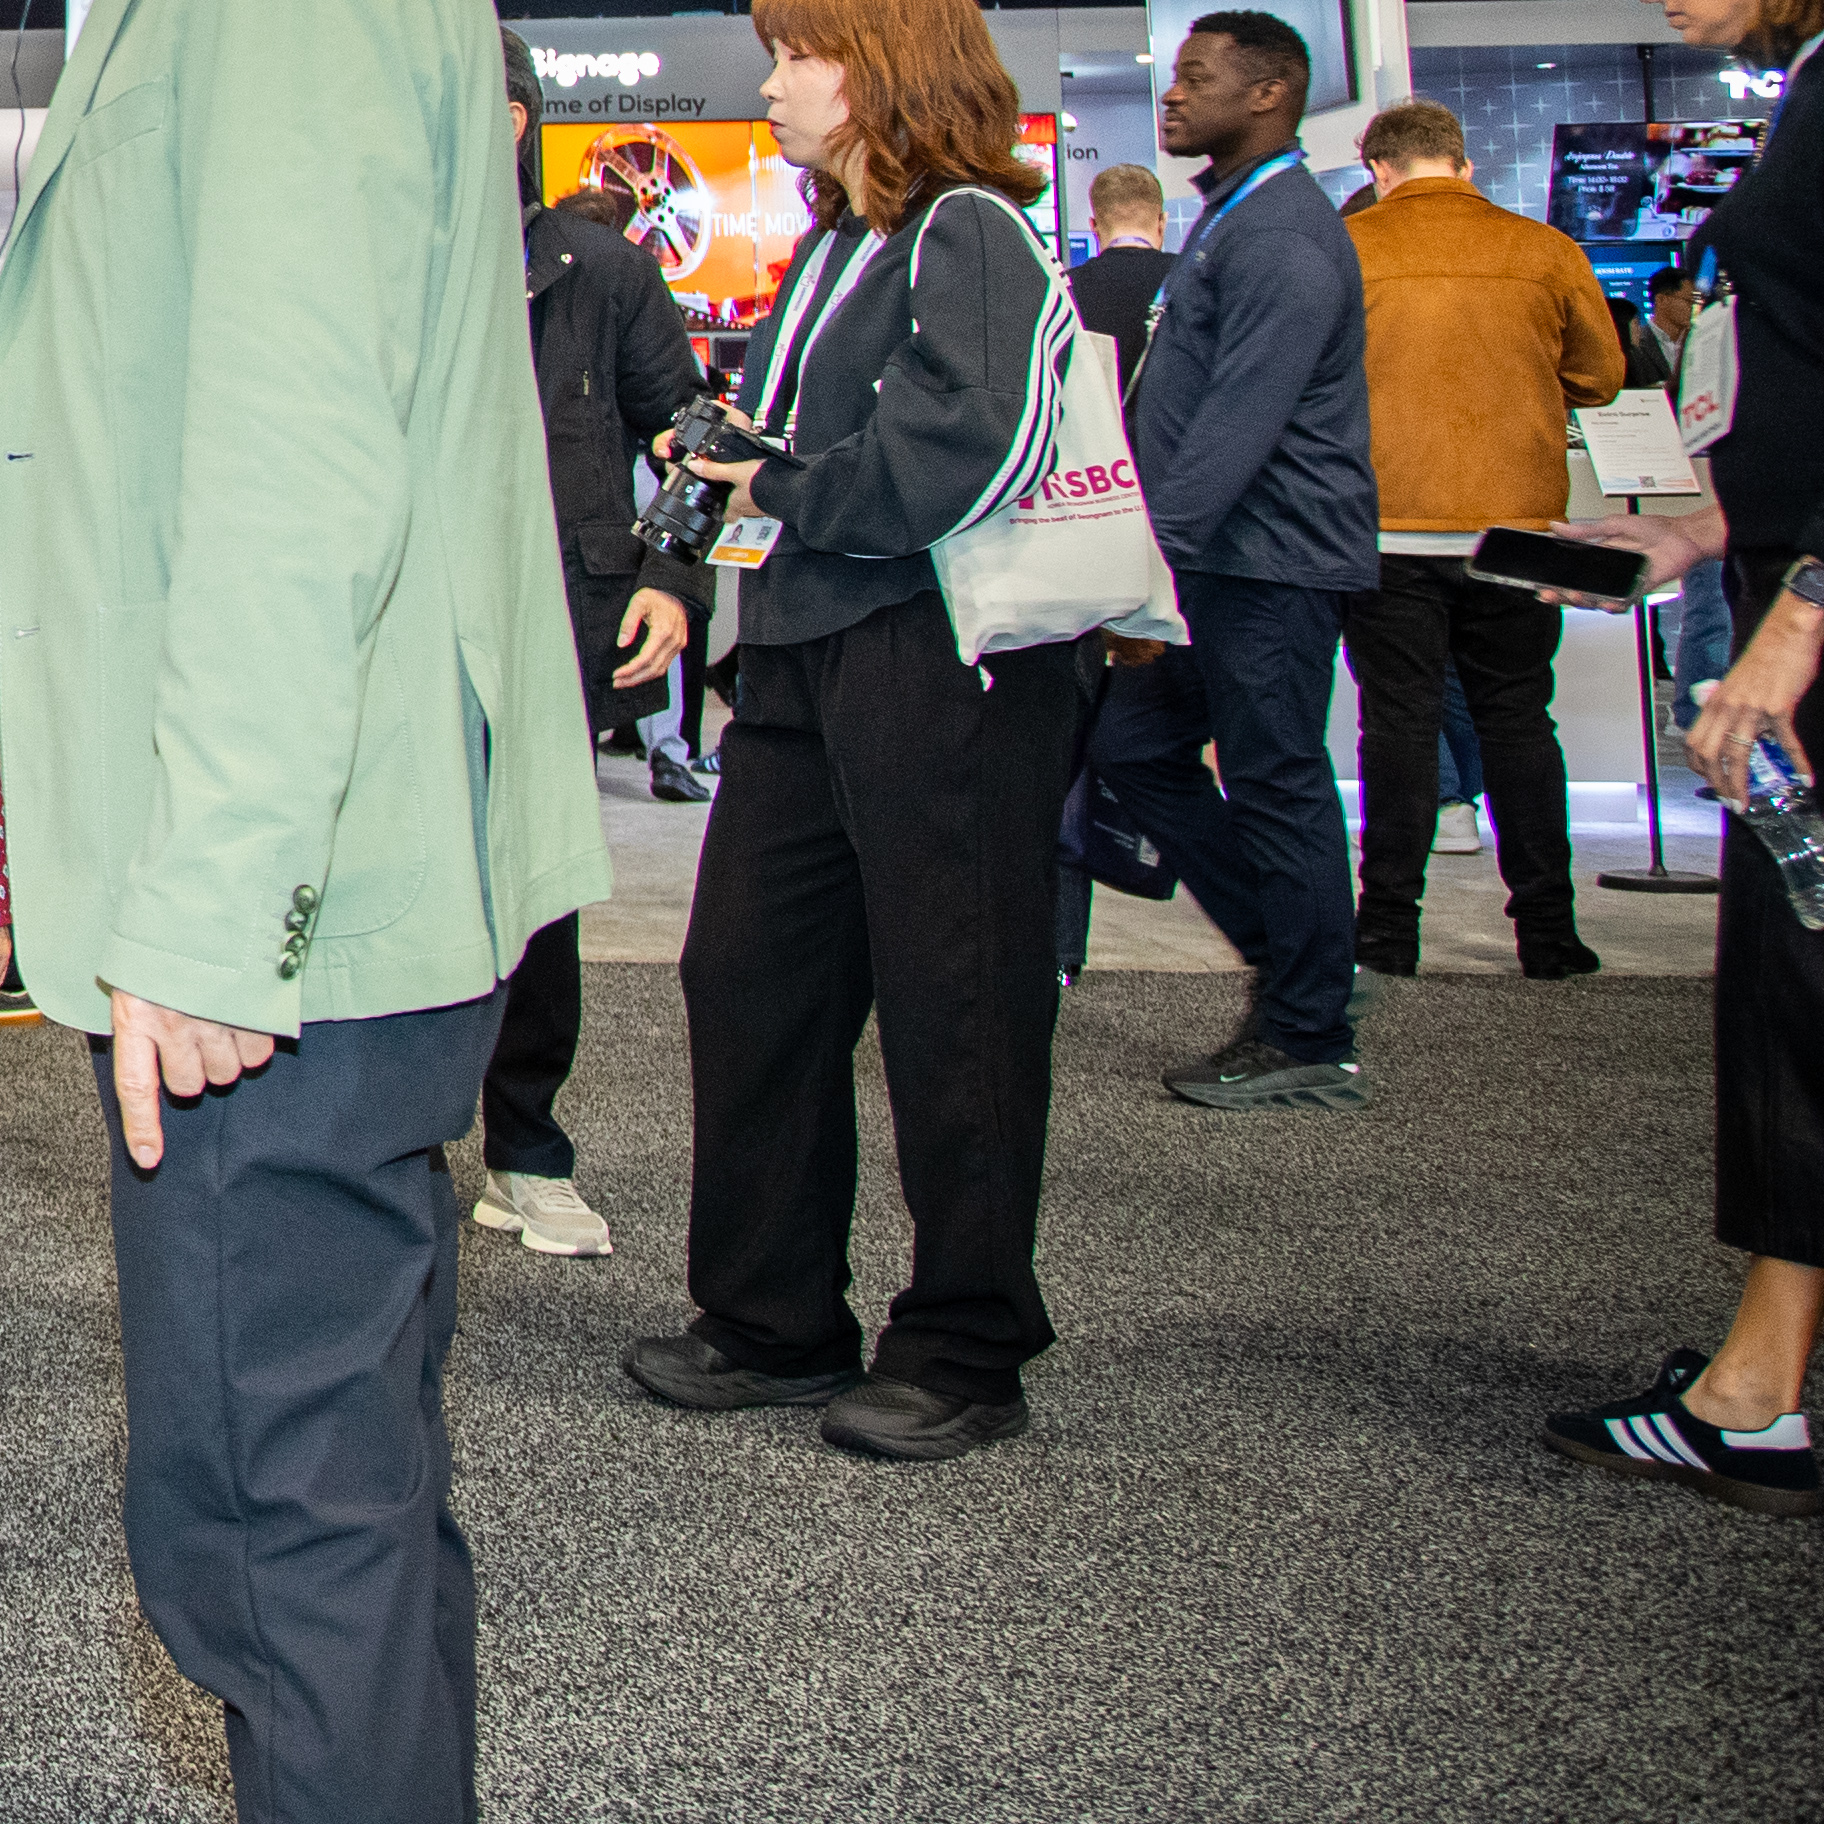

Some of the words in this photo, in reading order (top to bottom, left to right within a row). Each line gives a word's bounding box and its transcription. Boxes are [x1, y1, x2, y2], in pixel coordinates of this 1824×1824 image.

[588, 94, 614, 114] of
[618, 93, 706, 117] Display
[713, 212, 757, 237] TIME
[1009, 517, 1038, 525] Bringing
[1050, 514, 1068, 523] best
[1077, 511, 1113, 521] Seongnam
